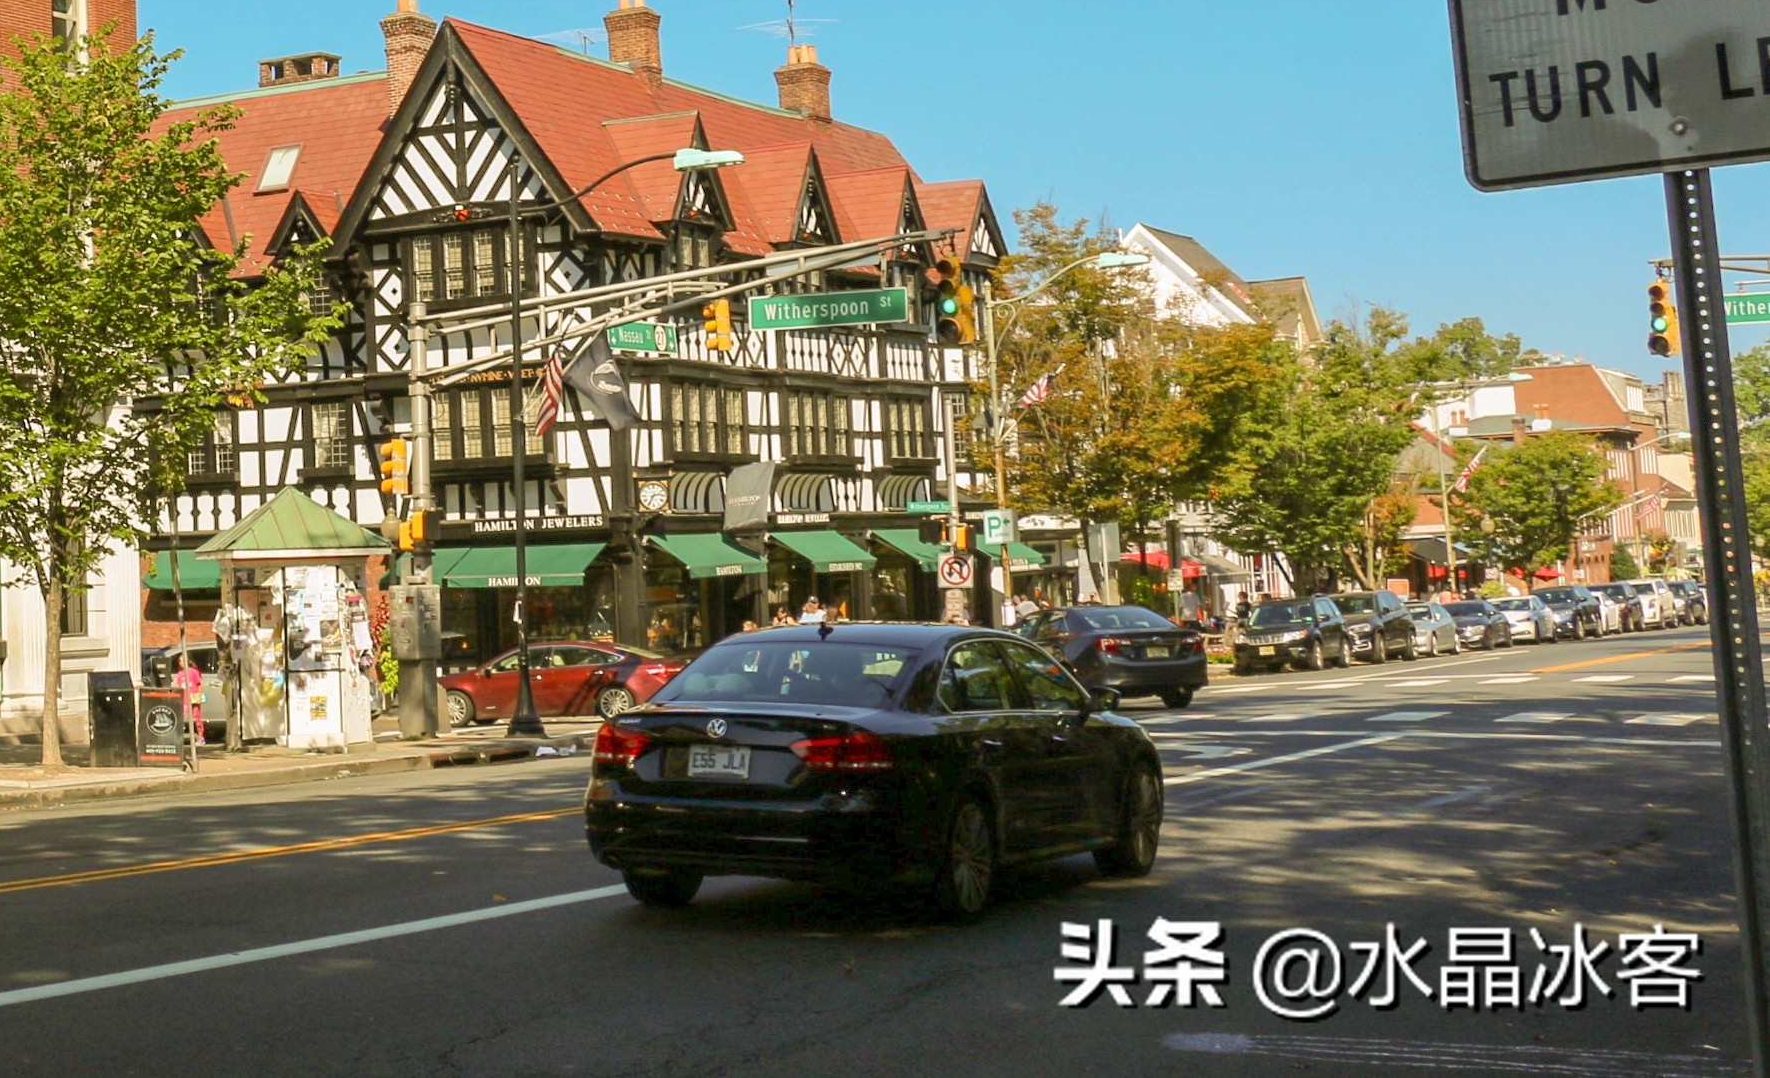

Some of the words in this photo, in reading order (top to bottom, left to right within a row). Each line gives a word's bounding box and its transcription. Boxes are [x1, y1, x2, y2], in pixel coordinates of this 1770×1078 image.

[1488, 51, 1663, 127] TURN
[763, 298, 869, 321] Witherspoon
[880, 295, 892, 308] St
[618, 326, 644, 344] Nassau
[474, 519, 535, 532] HAMILTN
[541, 516, 603, 529] JEWELERS
